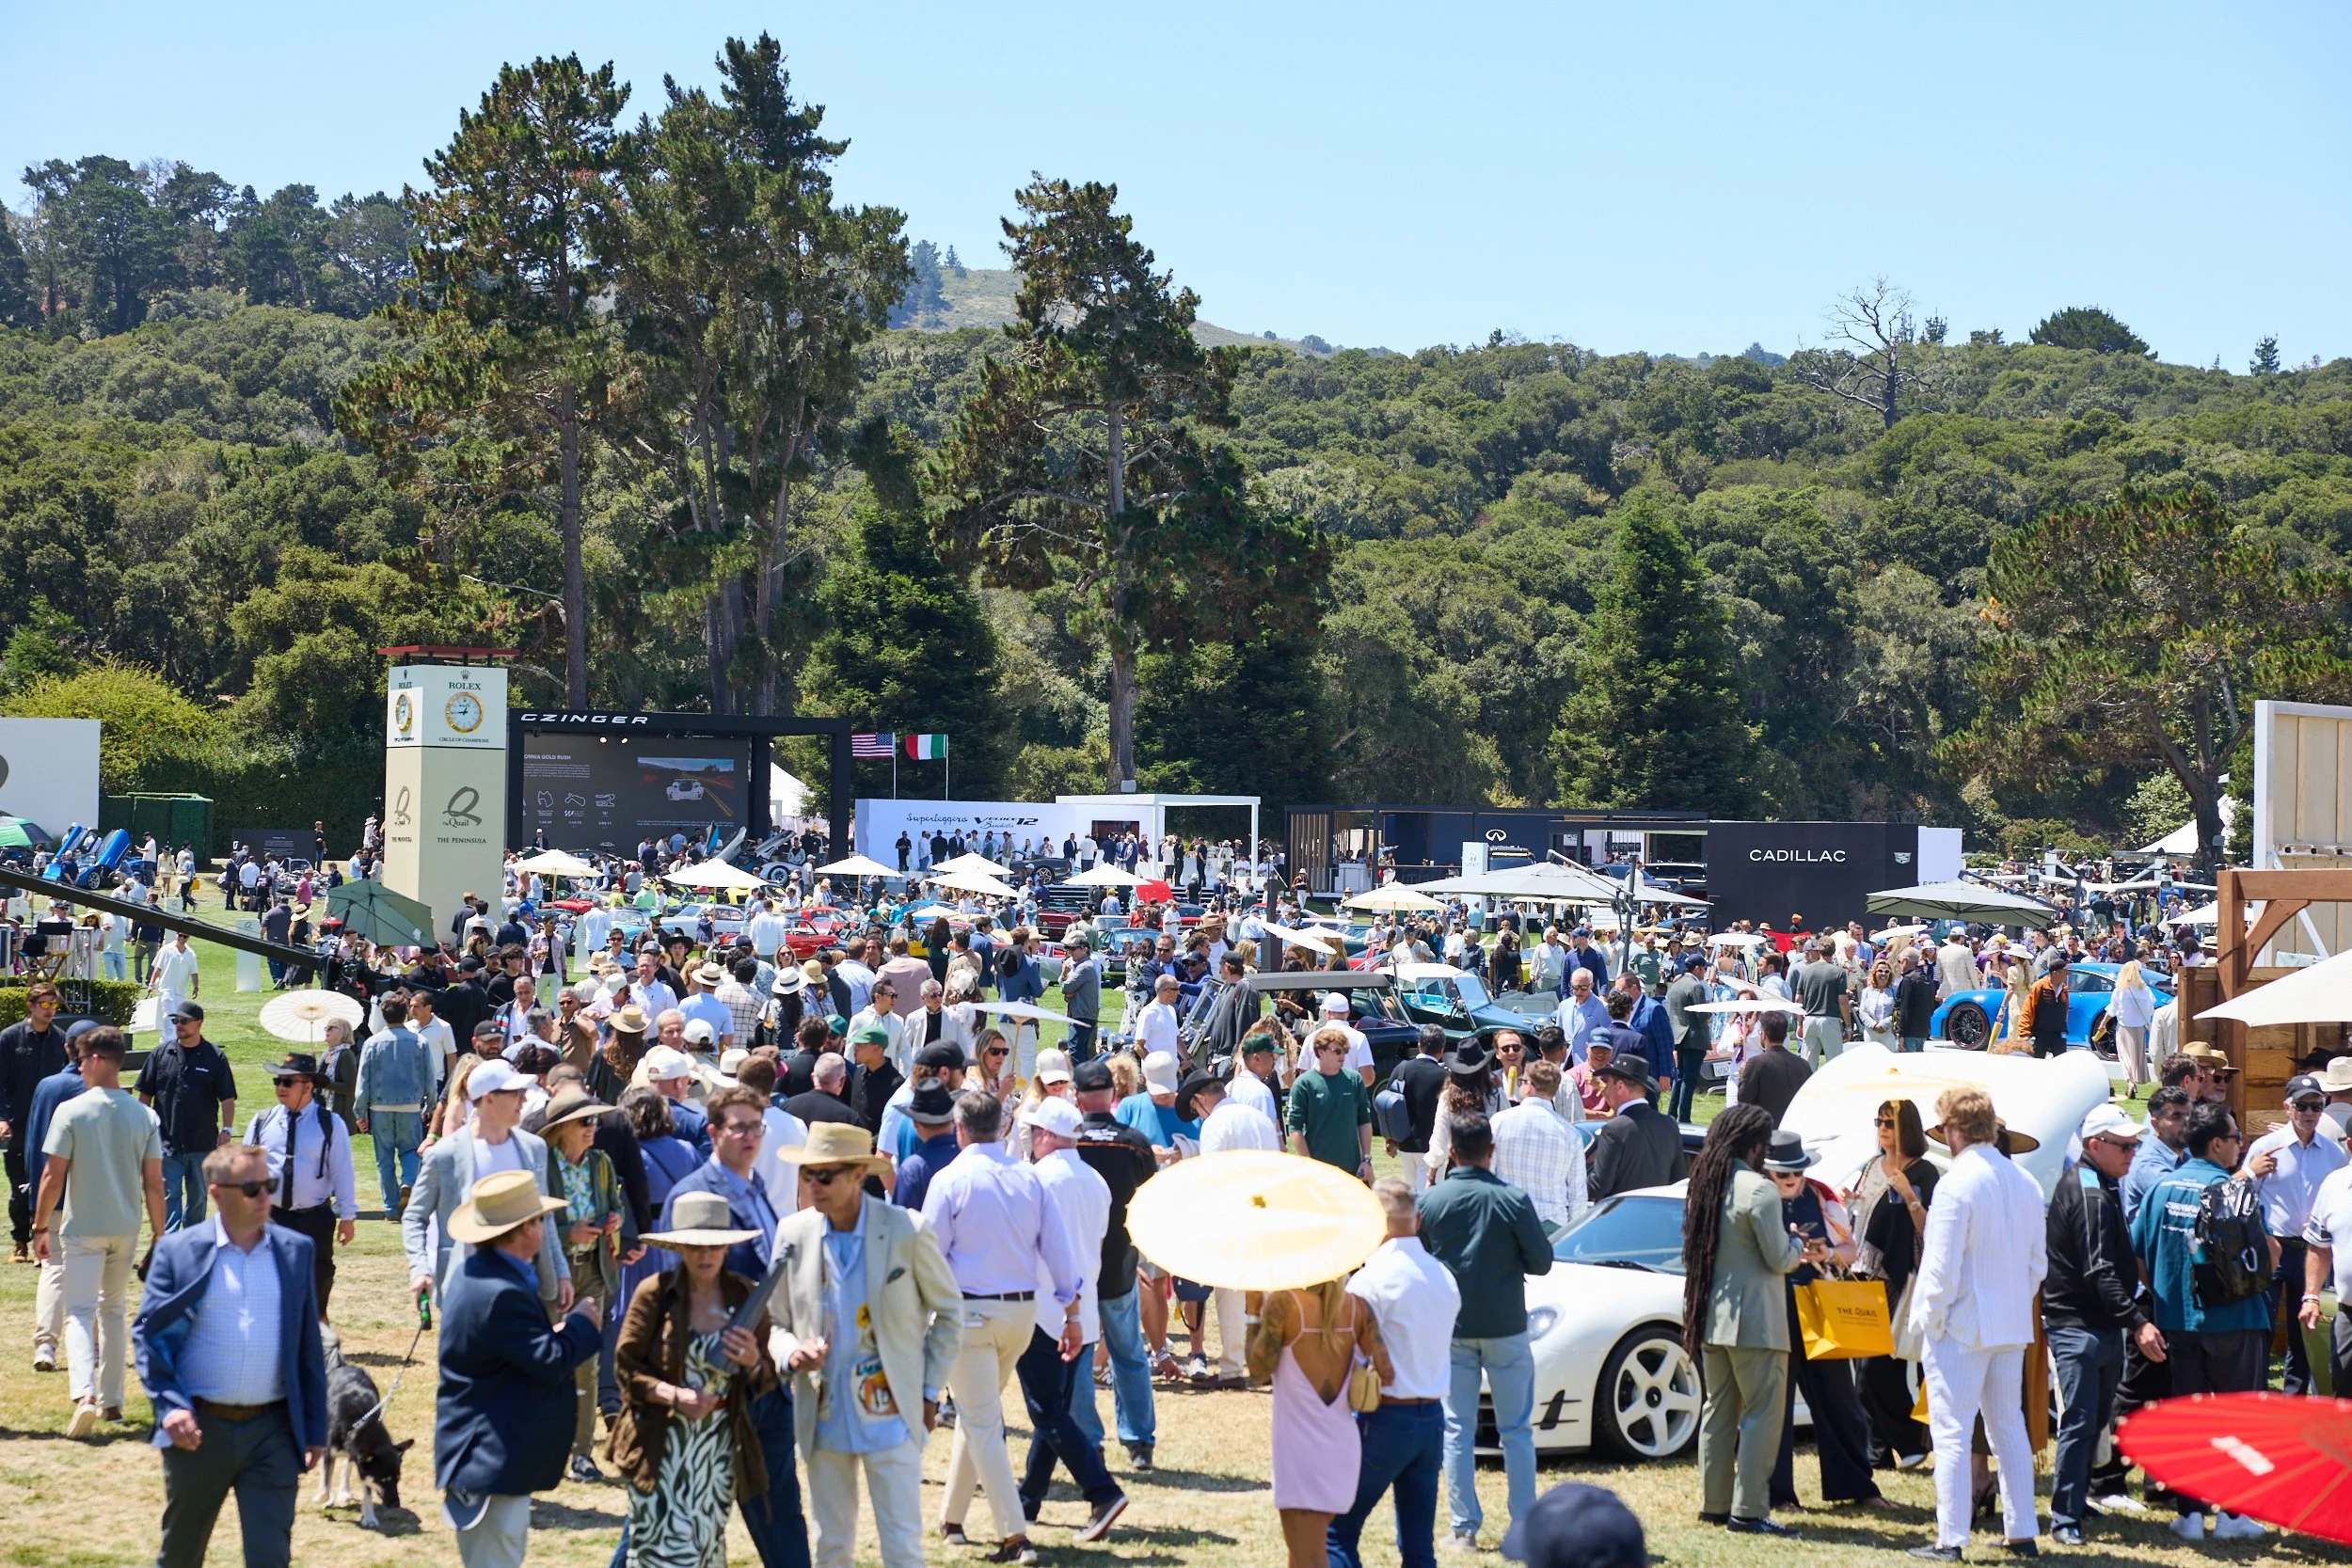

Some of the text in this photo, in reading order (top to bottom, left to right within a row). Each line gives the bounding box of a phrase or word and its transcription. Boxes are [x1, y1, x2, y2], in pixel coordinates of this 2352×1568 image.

[520, 713, 648, 724] CZINGER
[449, 818, 469, 828] Quail
[1749, 849, 1846, 863] CADILLAC
